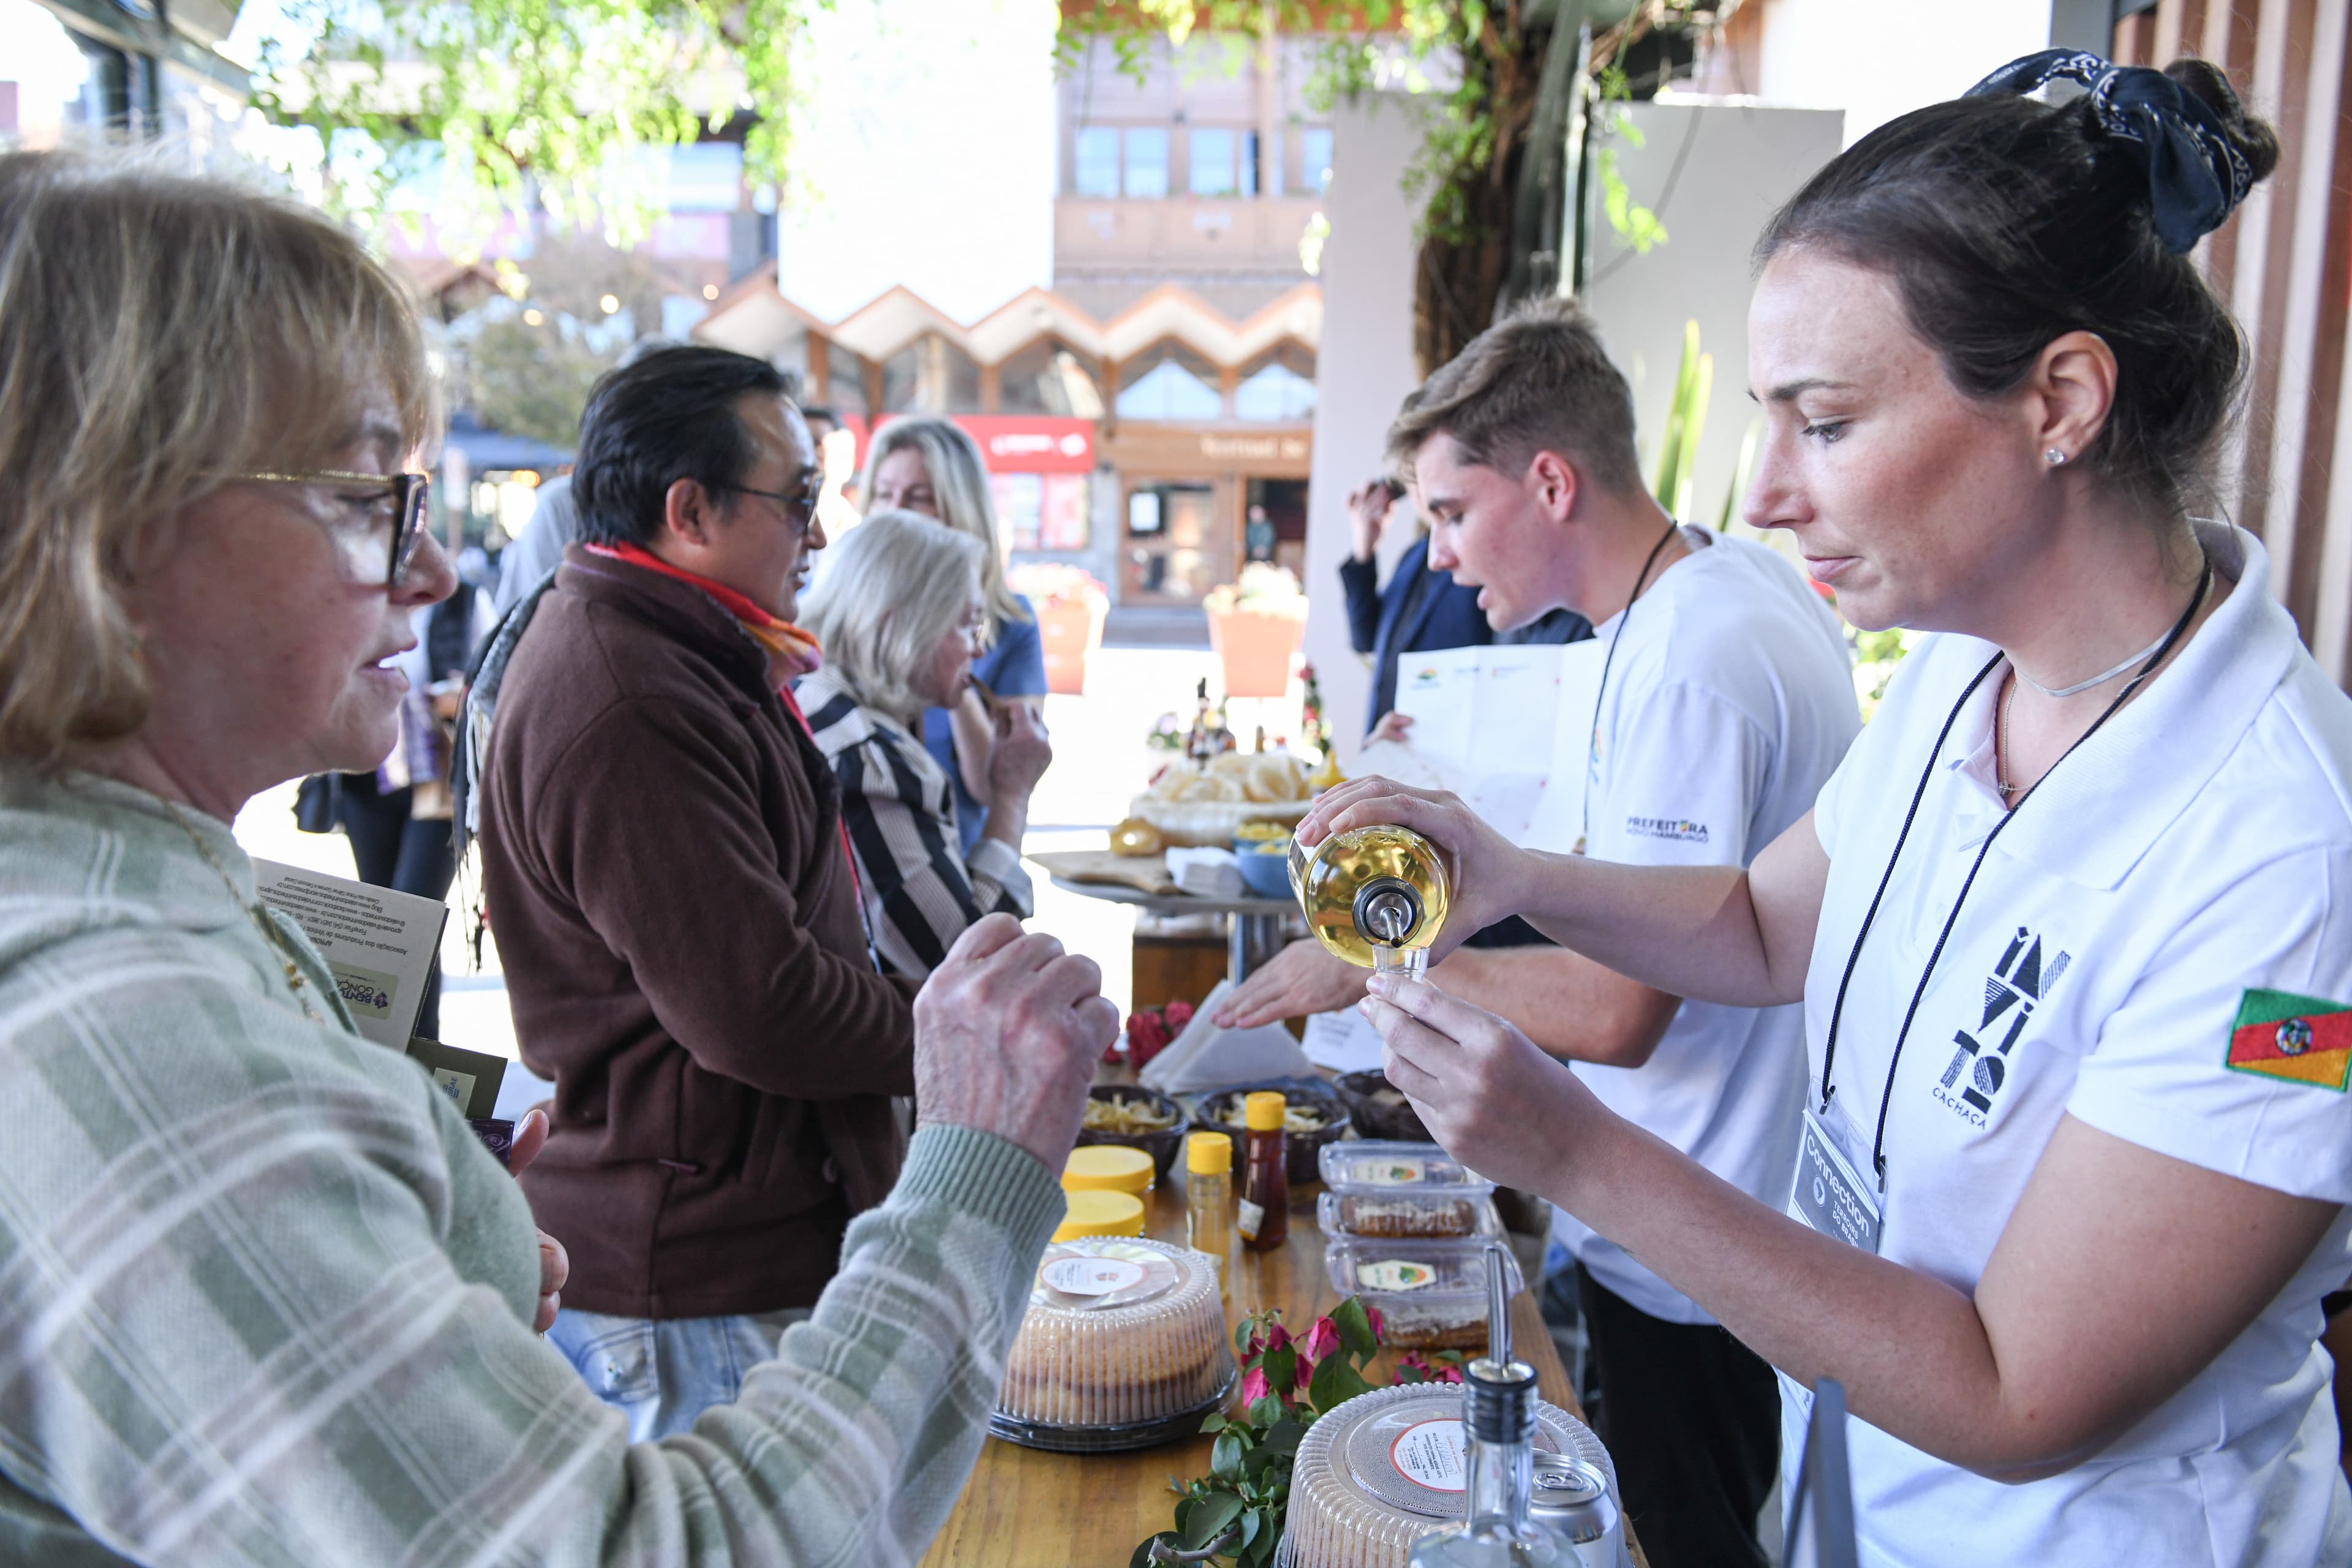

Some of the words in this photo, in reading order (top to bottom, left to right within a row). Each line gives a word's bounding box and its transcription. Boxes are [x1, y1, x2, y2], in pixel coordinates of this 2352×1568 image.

[1651, 831, 1709, 844] HAMBURGO
[371, 904, 383, 913] Blog
[306, 926, 324, 936] Vinhos
[334, 933, 364, 946] Produtores
[376, 943, 407, 955] Associação
[1932, 1087, 1987, 1130] CACHAÇA
[1807, 1134, 1869, 1238] Connection
[1832, 1210, 1841, 1224] DO
[1833, 1200, 1858, 1240] TERROIRS
